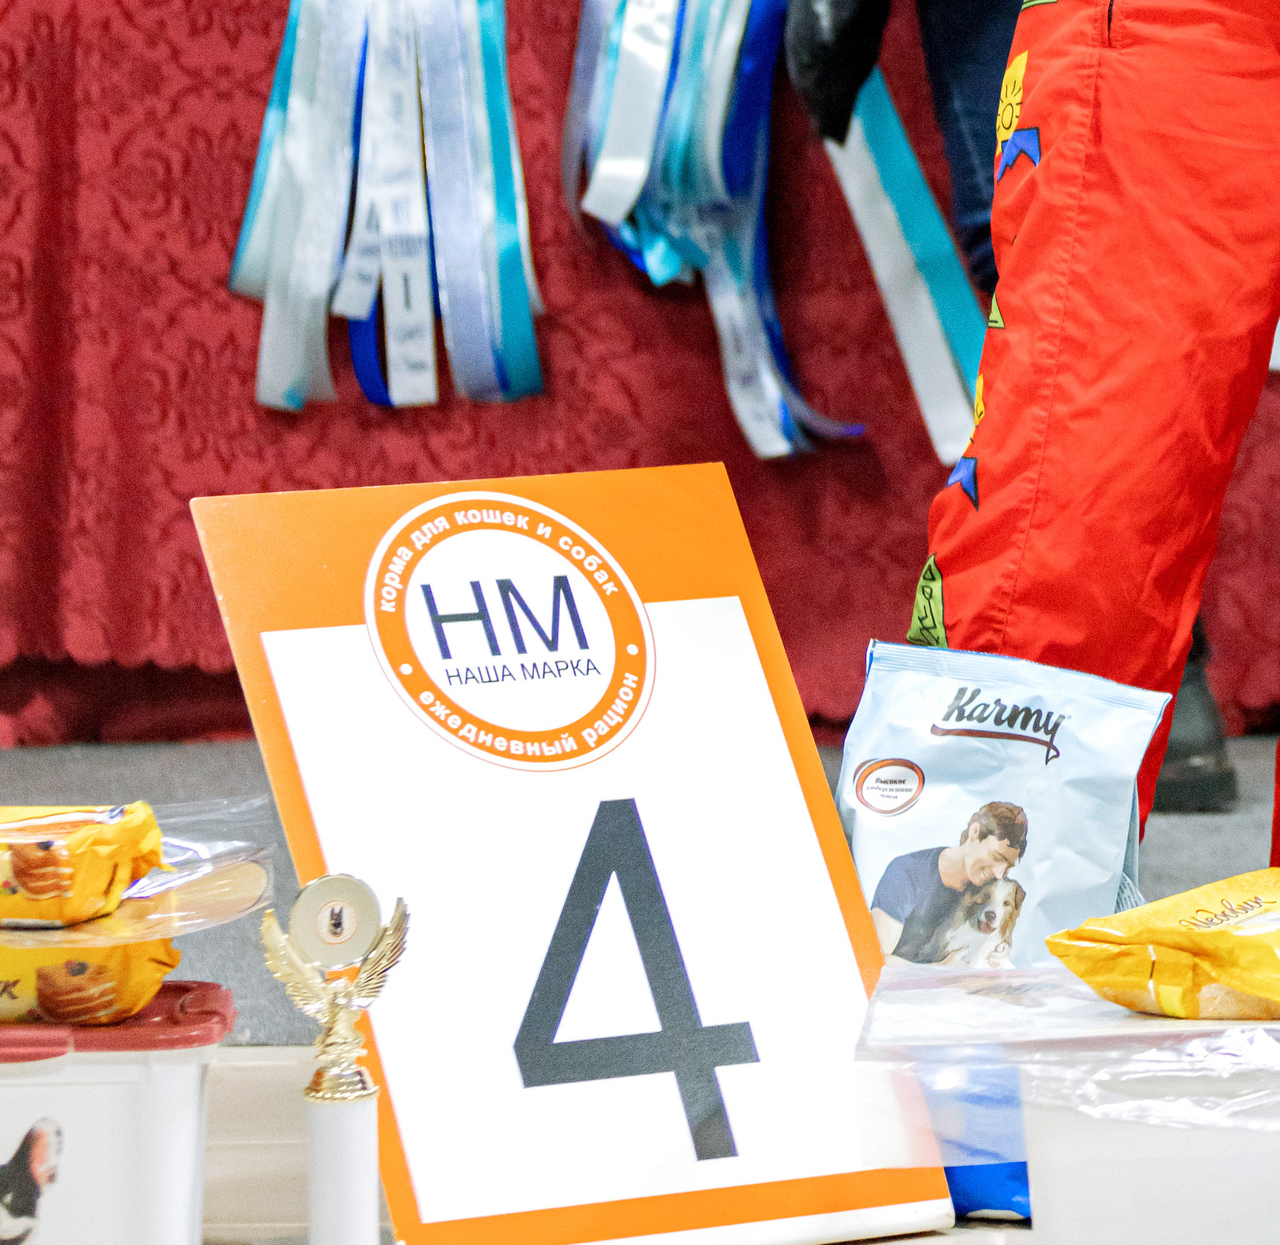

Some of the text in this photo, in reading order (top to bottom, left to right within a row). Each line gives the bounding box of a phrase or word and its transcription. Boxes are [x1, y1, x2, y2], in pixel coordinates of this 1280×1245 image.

[381, 509, 618, 612] корма для кошек и собак
[419, 672, 639, 756] ежедневный рацион
[445, 658, 601, 686] НАША МАРКА
[941, 686, 1066, 765] Karmy
[512, 797, 761, 1161] 4
